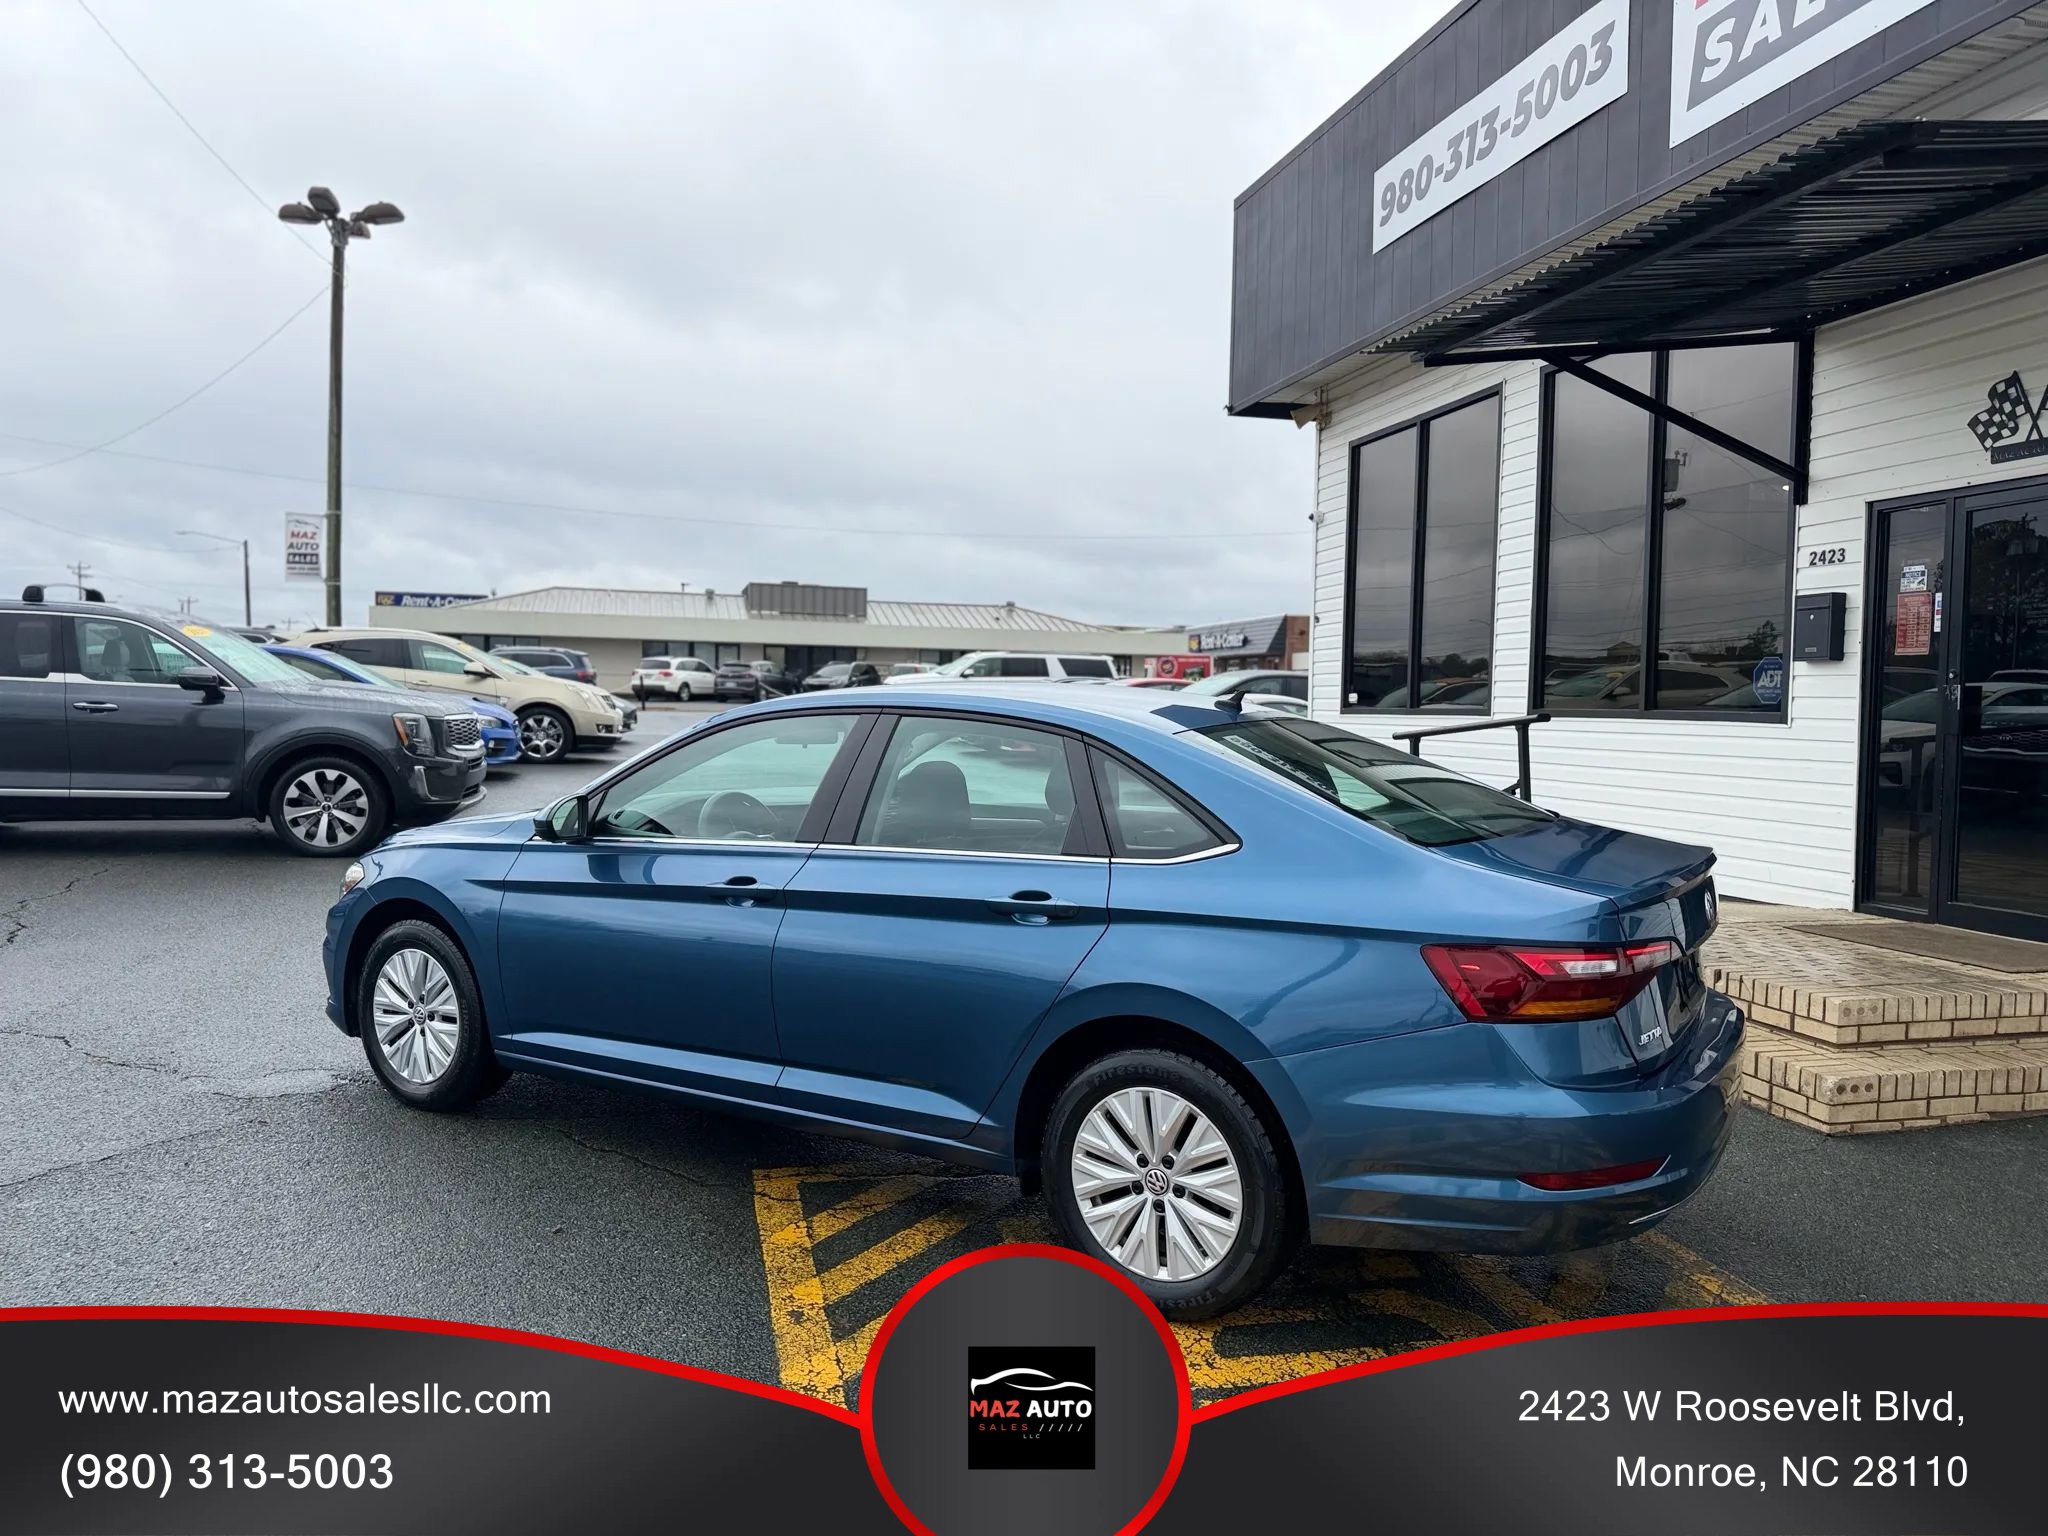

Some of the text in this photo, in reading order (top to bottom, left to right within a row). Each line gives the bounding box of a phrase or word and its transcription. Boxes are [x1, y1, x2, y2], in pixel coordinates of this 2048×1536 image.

[1379, 19, 1616, 228] 980-313-5003
[290, 530, 318, 541] MAZ
[287, 541, 320, 552] AUTO
[288, 553, 318, 563] SALES
[1809, 547, 1846, 567] 2423
[1757, 670, 1783, 688] ADT
